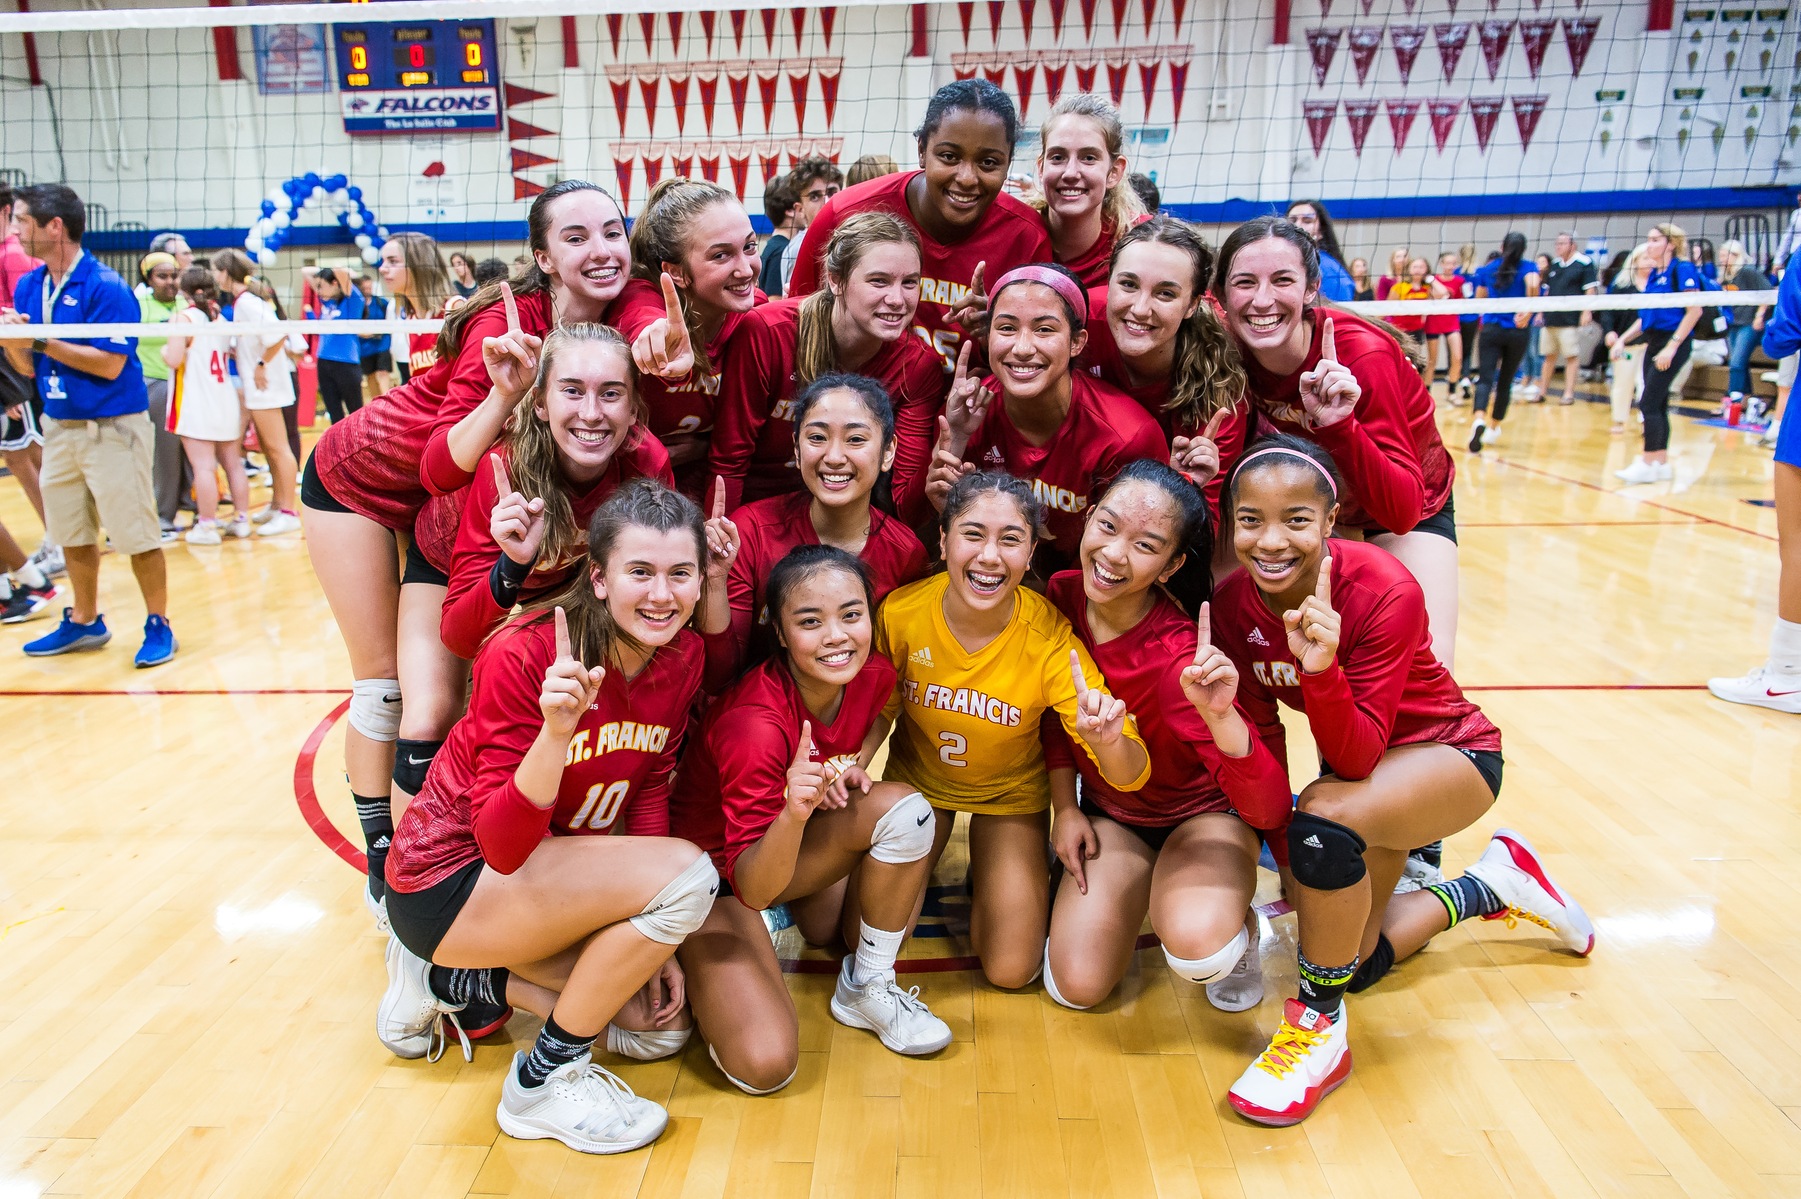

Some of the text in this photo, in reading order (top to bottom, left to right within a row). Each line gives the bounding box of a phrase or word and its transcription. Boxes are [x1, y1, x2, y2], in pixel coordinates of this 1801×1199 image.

[351, 46, 367, 70] 0
[409, 44, 425, 68] 0
[465, 43, 481, 67] 0
[375, 95, 492, 113] FALCONS
[1247, 637, 1270, 647] adidas
[908, 655, 935, 669] adidas
[902, 678, 1022, 727] ST. FRANCIS
[564, 720, 672, 768] ST. FRANCIS
[938, 730, 968, 768] 2
[568, 779, 631, 830] 10
[1302, 839, 1324, 849] adidas
